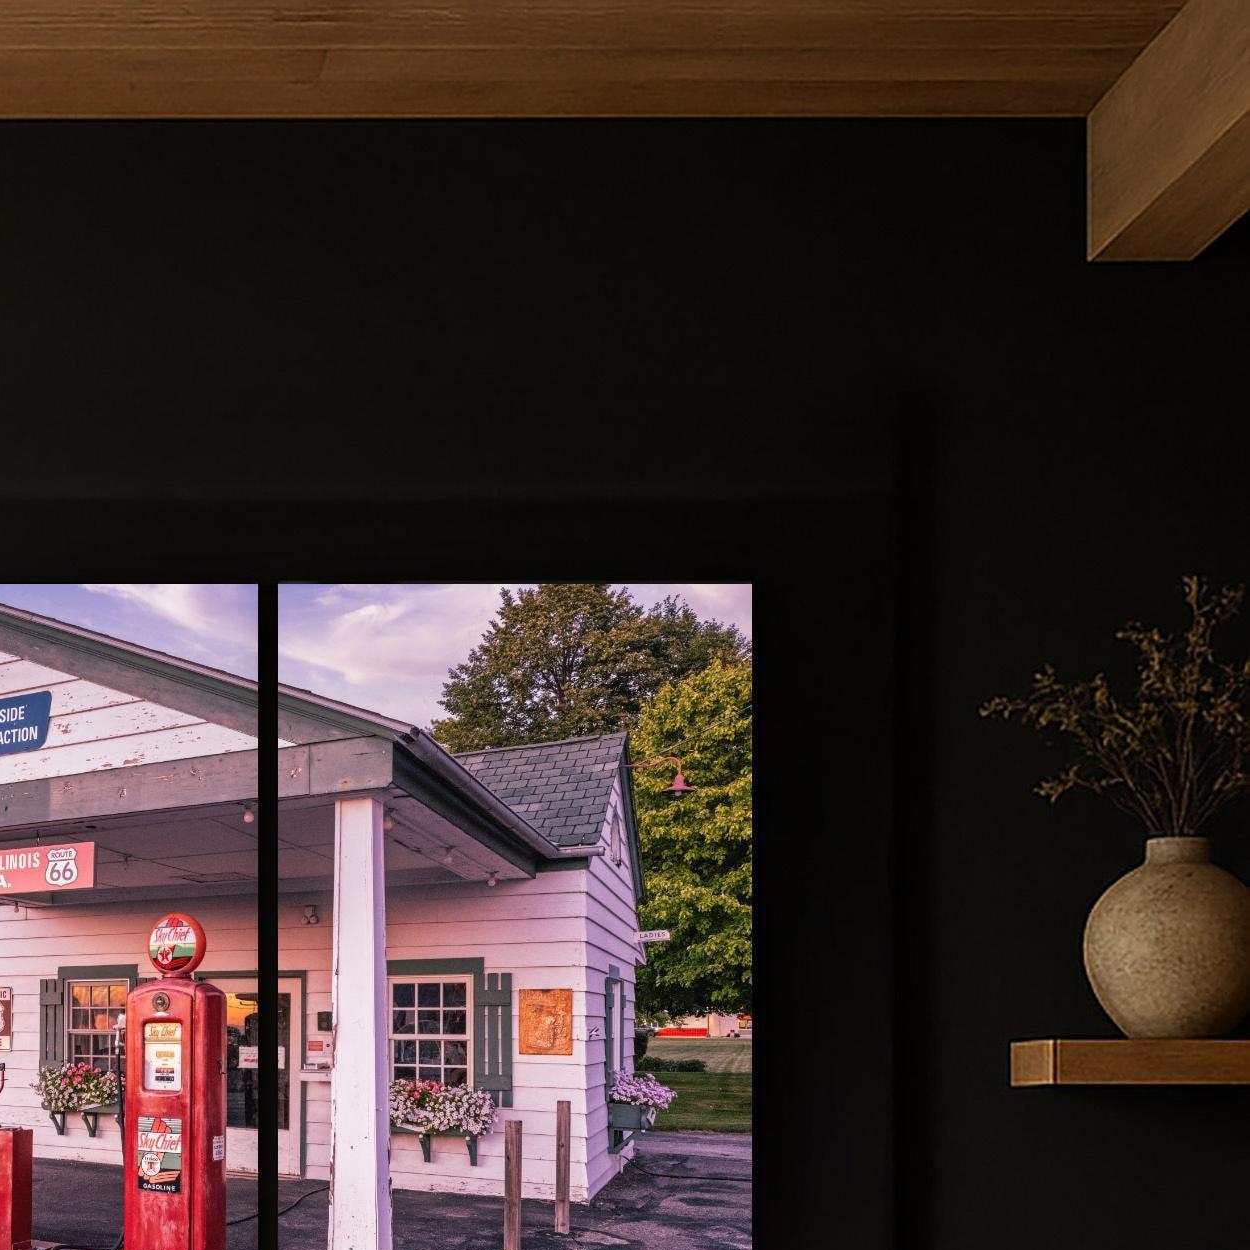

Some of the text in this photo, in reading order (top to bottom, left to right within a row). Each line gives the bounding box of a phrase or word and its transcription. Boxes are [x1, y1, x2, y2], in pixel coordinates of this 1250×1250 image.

[51, 850, 72, 858] ROUTE
[50, 862, 73, 881] 66
[138, 1133, 181, 1151] Sky Chief
[143, 1183, 176, 1191] GASOLINE
